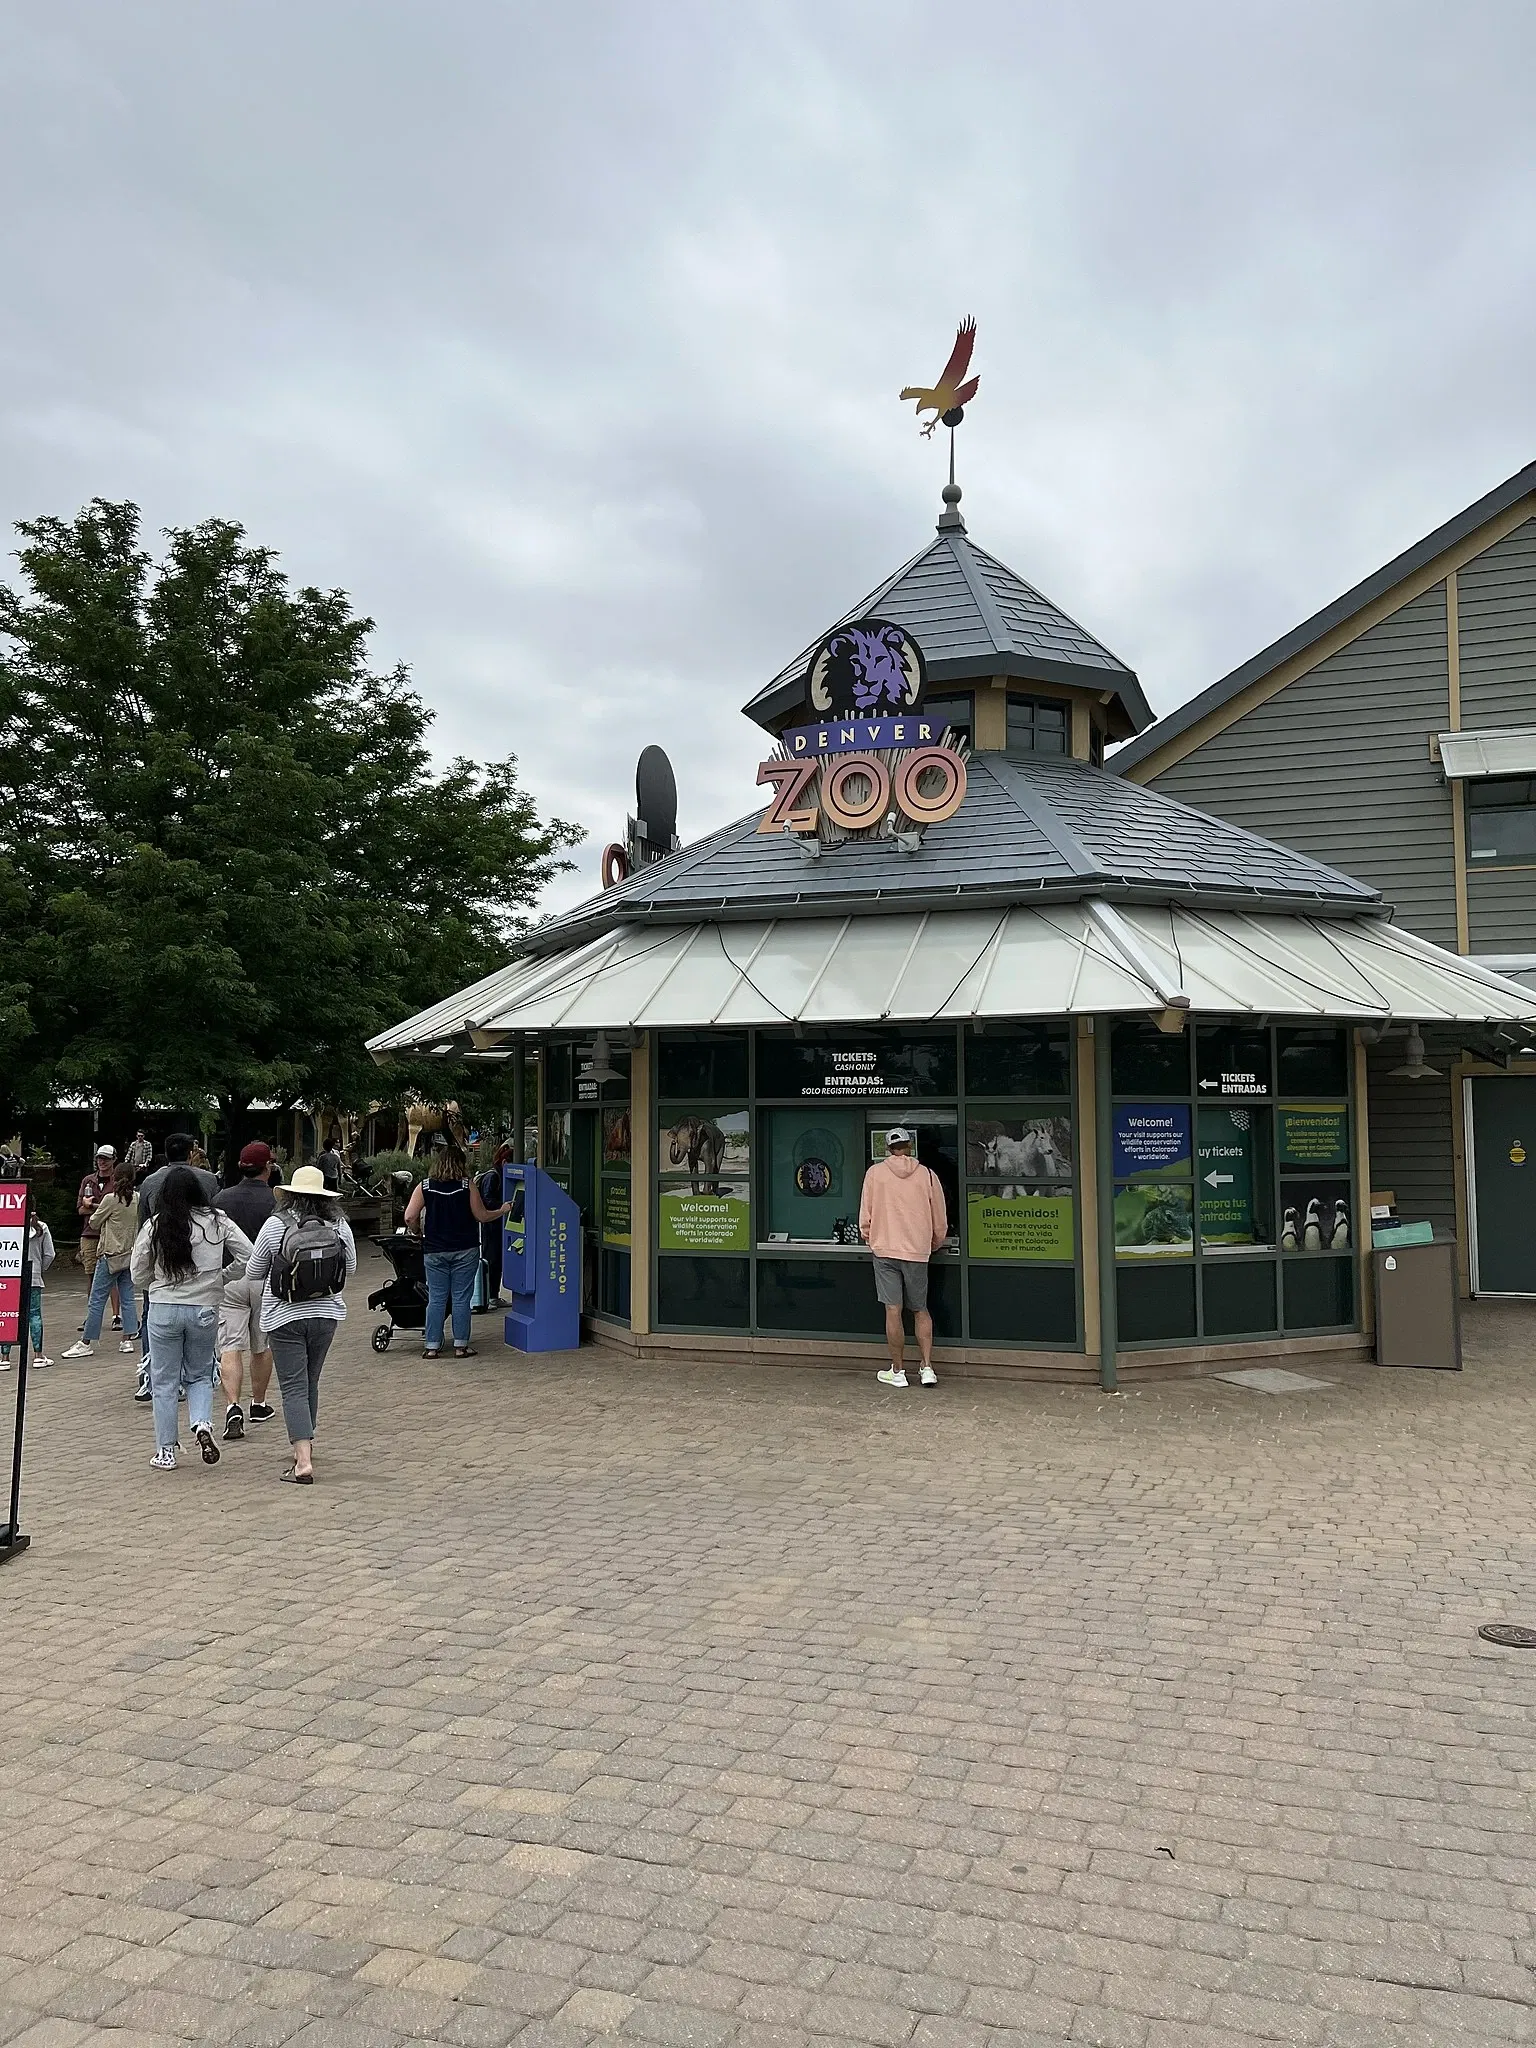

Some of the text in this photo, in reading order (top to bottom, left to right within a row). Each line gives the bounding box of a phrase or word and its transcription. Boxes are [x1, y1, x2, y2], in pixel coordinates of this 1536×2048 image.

[795, 724, 931, 751] DENVER
[756, 746, 968, 834] ZOO
[831, 1052, 877, 1062] TICKETS:
[835, 1063, 876, 1071] CASH ONLY
[824, 1076, 884, 1086] ENTRADAS:
[1220, 1073, 1256, 1083] TICKETS
[801, 1087, 821, 1095] SOLO
[821, 1087, 856, 1095] REGISTRO
[1221, 1084, 1267, 1094] ENTRADAS
[1128, 1117, 1173, 1127] Welcome!
[1198, 1146, 1243, 1158] uy tickets
[680, 1203, 729, 1213] Welcome!
[1199, 1198, 1247, 1210] ompra tus
[982, 1208, 1059, 1219] ¡Bienvenidos!
[1199, 1211, 1242, 1222] entradas
[699, 1216, 727, 1224] supports
[1027, 1222, 1052, 1231] ayuda
[549, 1207, 557, 1280] TICKETS
[558, 1222, 567, 1294] BOLETOS
